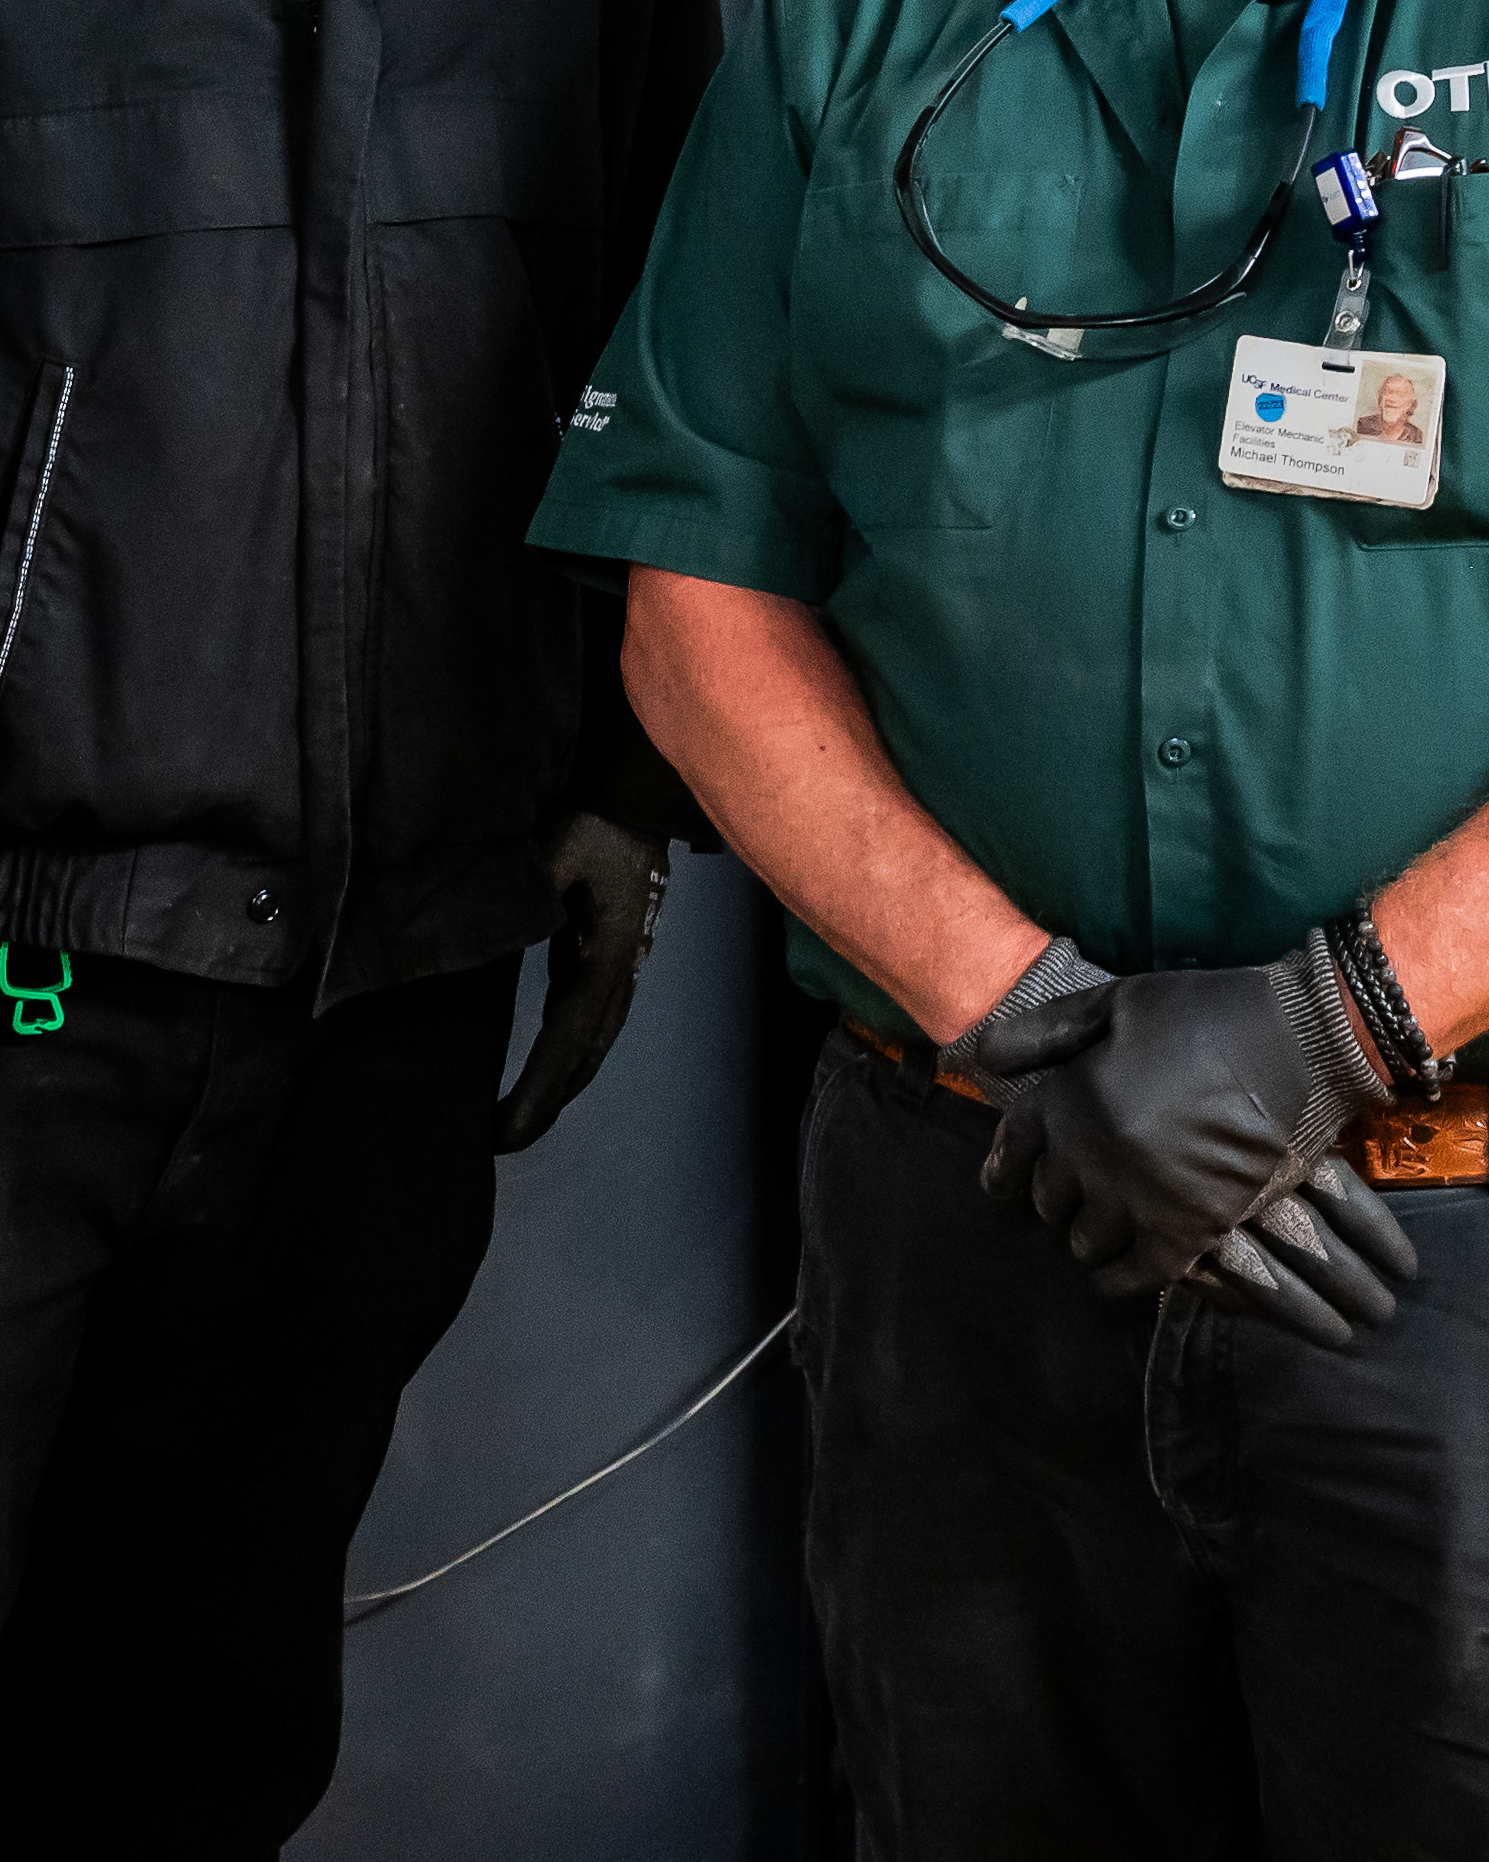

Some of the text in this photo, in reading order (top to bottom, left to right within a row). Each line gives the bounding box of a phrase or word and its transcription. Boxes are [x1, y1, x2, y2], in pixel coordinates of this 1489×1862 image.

[1241, 374, 1350, 402] UCSF Medical Center
[1232, 433, 1276, 448] Facilities
[1234, 420, 1325, 444] Elevator Mechanic
[1230, 446, 1345, 475] Michael Thompson
